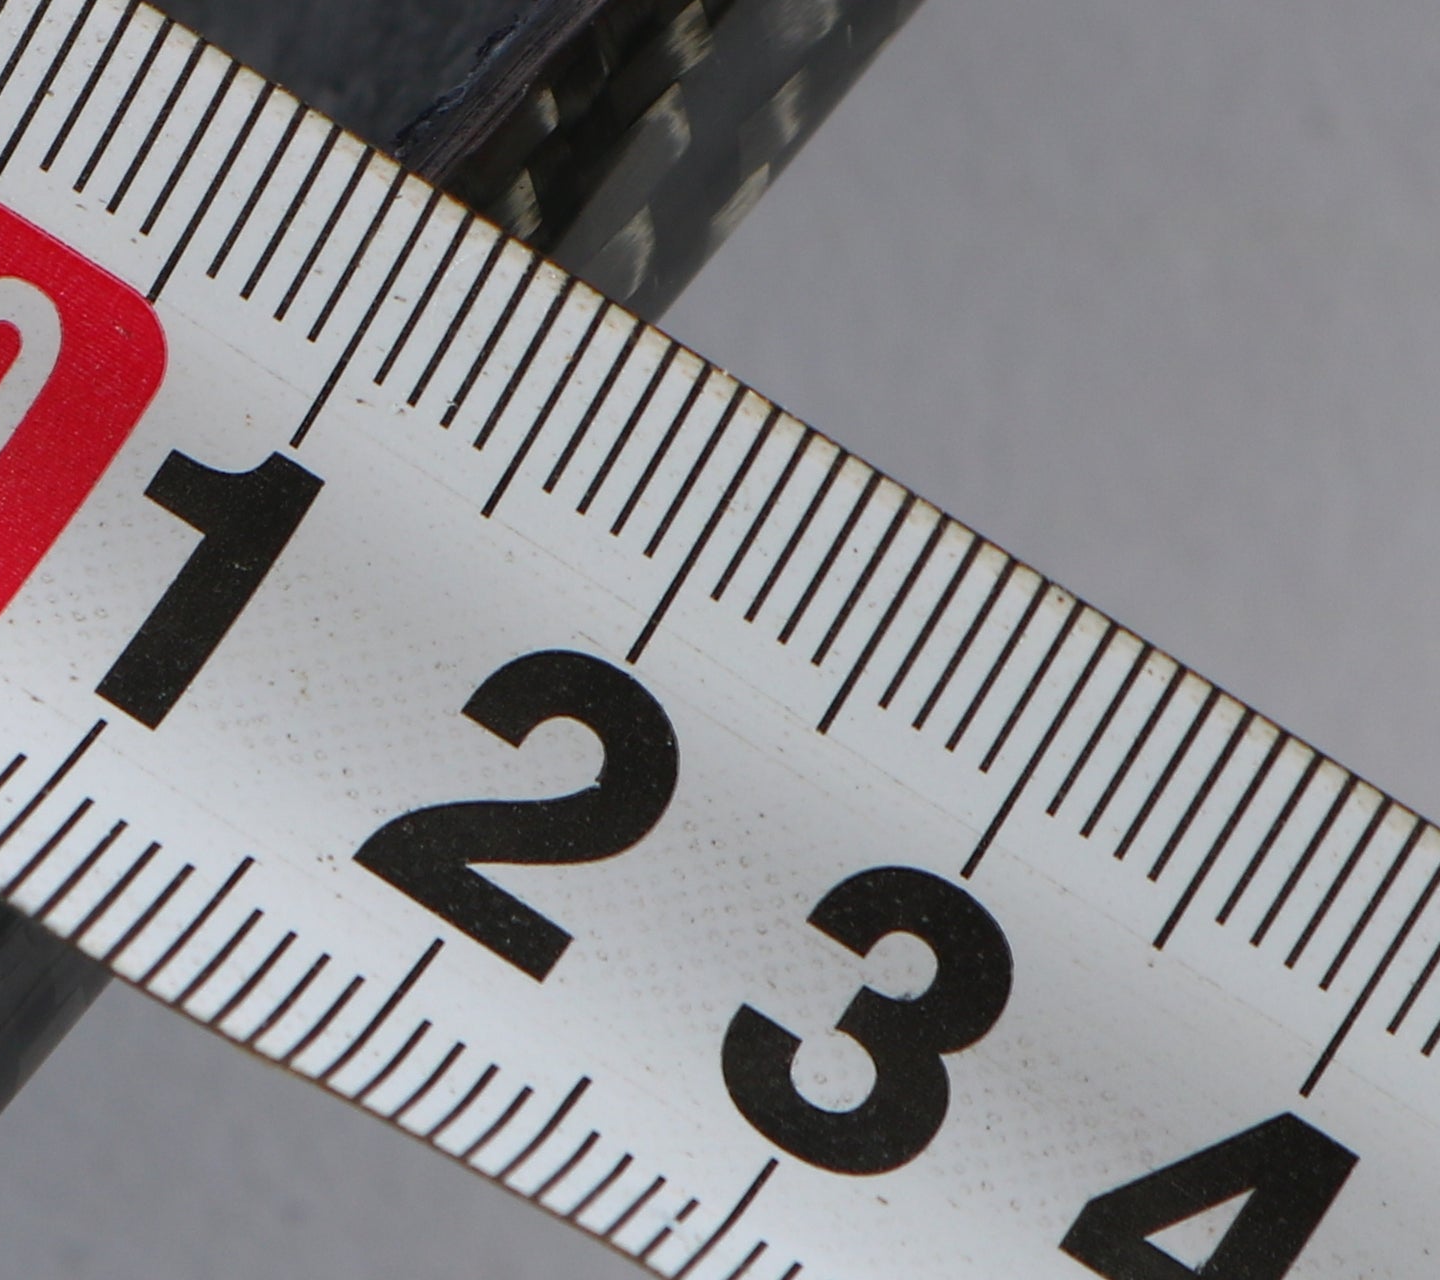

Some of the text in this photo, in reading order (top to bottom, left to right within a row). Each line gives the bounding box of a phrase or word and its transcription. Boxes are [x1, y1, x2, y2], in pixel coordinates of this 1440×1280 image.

[93, 448, 326, 732] 1
[351, 648, 681, 984] 2
[720, 864, 1015, 1177] 3
